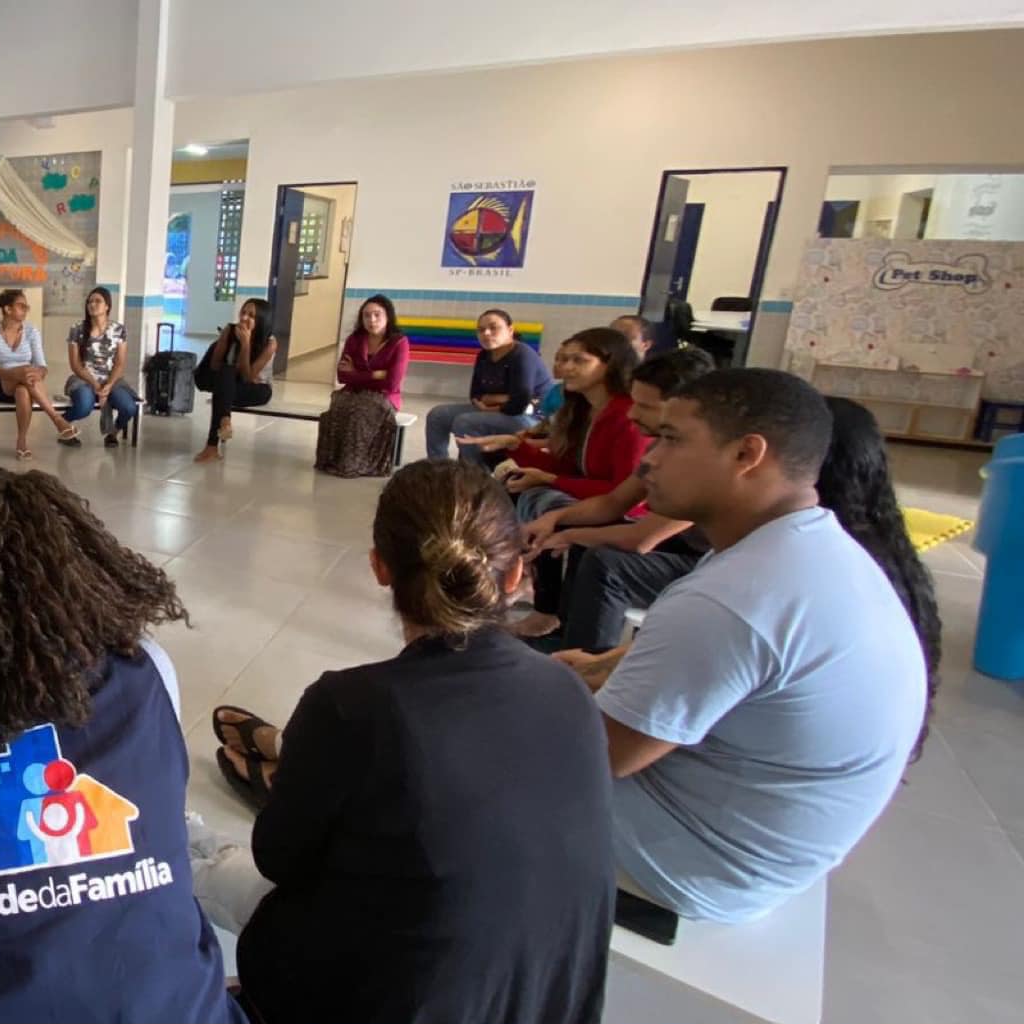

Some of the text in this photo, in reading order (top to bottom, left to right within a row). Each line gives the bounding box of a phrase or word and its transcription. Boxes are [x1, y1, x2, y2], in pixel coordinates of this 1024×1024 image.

[474, 180, 536, 190] SEBASTIÃO
[890, 268, 979, 285] Pet Shop
